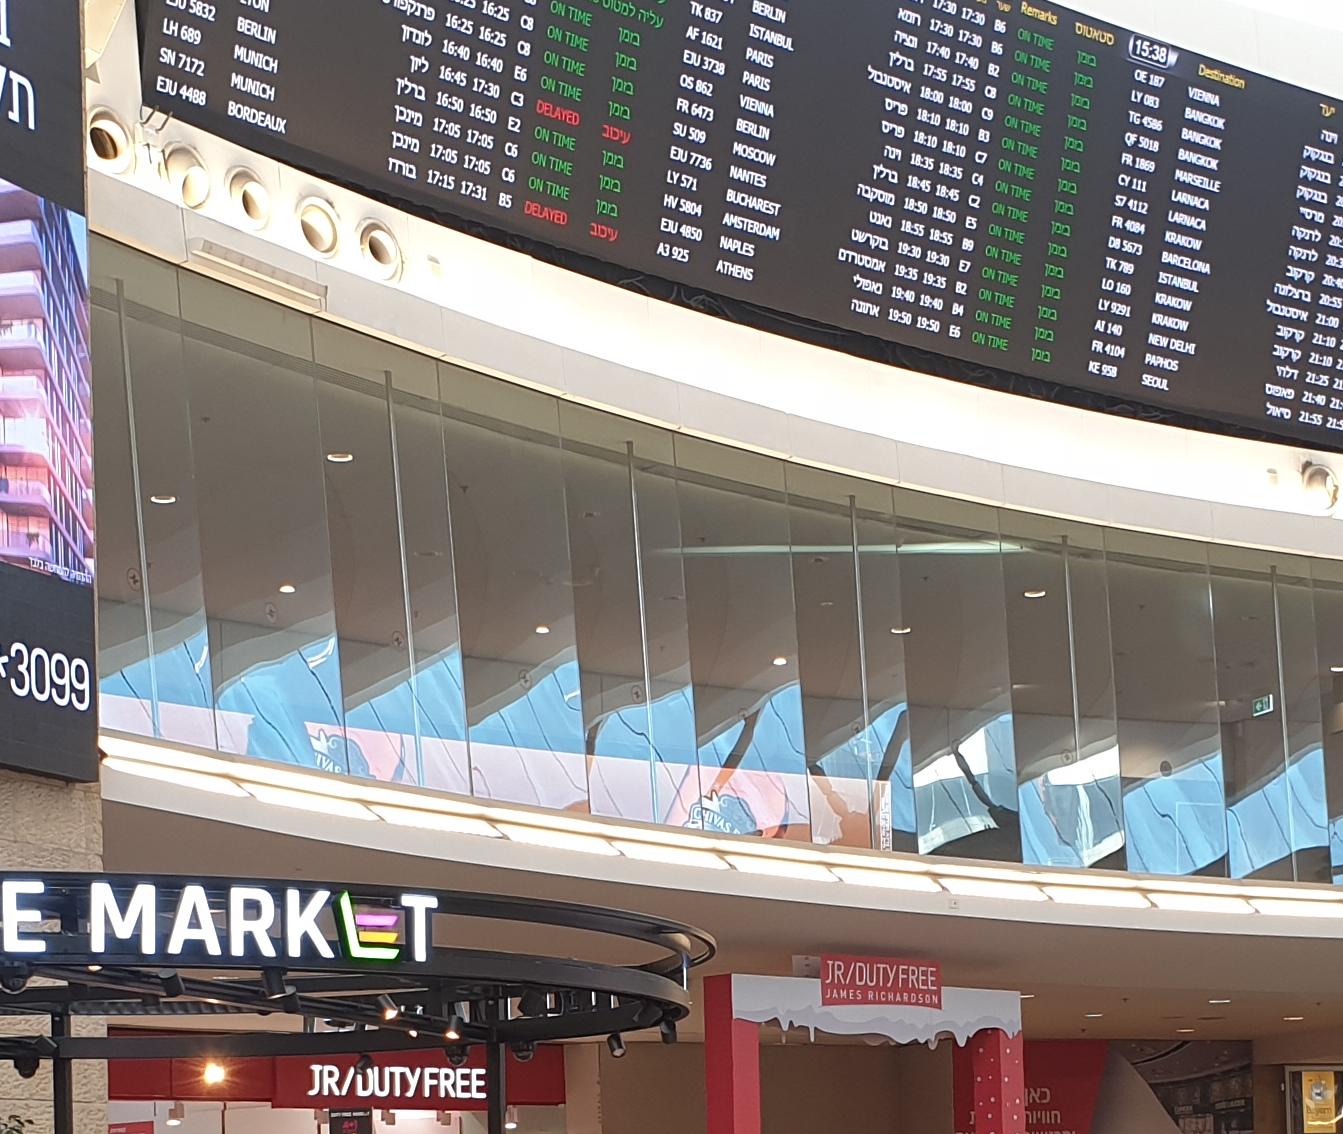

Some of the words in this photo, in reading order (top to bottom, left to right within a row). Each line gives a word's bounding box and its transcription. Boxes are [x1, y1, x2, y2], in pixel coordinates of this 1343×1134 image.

[1021, 2, 1057, 25] Remarks
[163, 18, 178, 36] LH
[181, 26, 201, 44] 689
[234, 45, 278, 73] MUNICH
[1135, 39, 1167, 63] 15:38
[160, 48, 175, 66] SN
[178, 54, 205, 76] 7172
[231, 73, 275, 101] MUNICH
[1198, 64, 1245, 89] Destination
[157, 76, 177, 95] EJU
[180, 85, 206, 105] 4488
[228, 101, 286, 134] BORDEAUX
[395, 105, 422, 126] מינכן
[392, 131, 419, 152] מינכן
[433, 118, 461, 138] 17:05
[467, 129, 494, 149] 17:05
[505, 143, 518, 157] C6
[430, 144, 458, 164] 17:05
[464, 155, 491, 174] 17:05
[502, 168, 515, 182] C6
[733, 142, 776, 166] MOSCOW
[529, 177, 543, 192] ON
[546, 182, 570, 200] TIME
[730, 166, 767, 187] NANTES
[1175, 169, 1221, 192] MARSEILLE
[427, 170, 455, 189] 17:15
[461, 181, 487, 200] 17:31
[499, 193, 512, 208] B5
[1172, 190, 1209, 210] LARNACA
[525, 201, 567, 225] DELAYED
[726, 189, 781, 216] BUCHAREST
[590, 223, 619, 241] עיכוב
[661, 218, 678, 234] EJU
[680, 225, 702, 241] 4850
[720, 236, 755, 257] NAPLES
[722, 213, 780, 240] AMSTERDAM
[657, 243, 670, 257] A3
[672, 247, 689, 262] 925
[716, 260, 754, 280] ATHENS
[891, 287, 915, 302] 19:40
[920, 295, 943, 310] 19:40
[952, 303, 964, 316] B4
[888, 309, 912, 325] 19:50
[917, 317, 940, 332] 19:50
[949, 325, 961, 338] E6
[972, 332, 985, 344] ON
[988, 335, 1008, 351] TIME
[1148, 333, 1168, 348] NEW
[1170, 336, 1196, 355] DELHI
[1088, 361, 1101, 374] KE
[1142, 374, 1169, 390] SEOUL
[1299, 411, 1323, 426] 21:55
[89, 881, 439, 963] MARKET
[825, 989, 862, 1000] JAMES
[868, 991, 938, 1004] RICHARDSON
